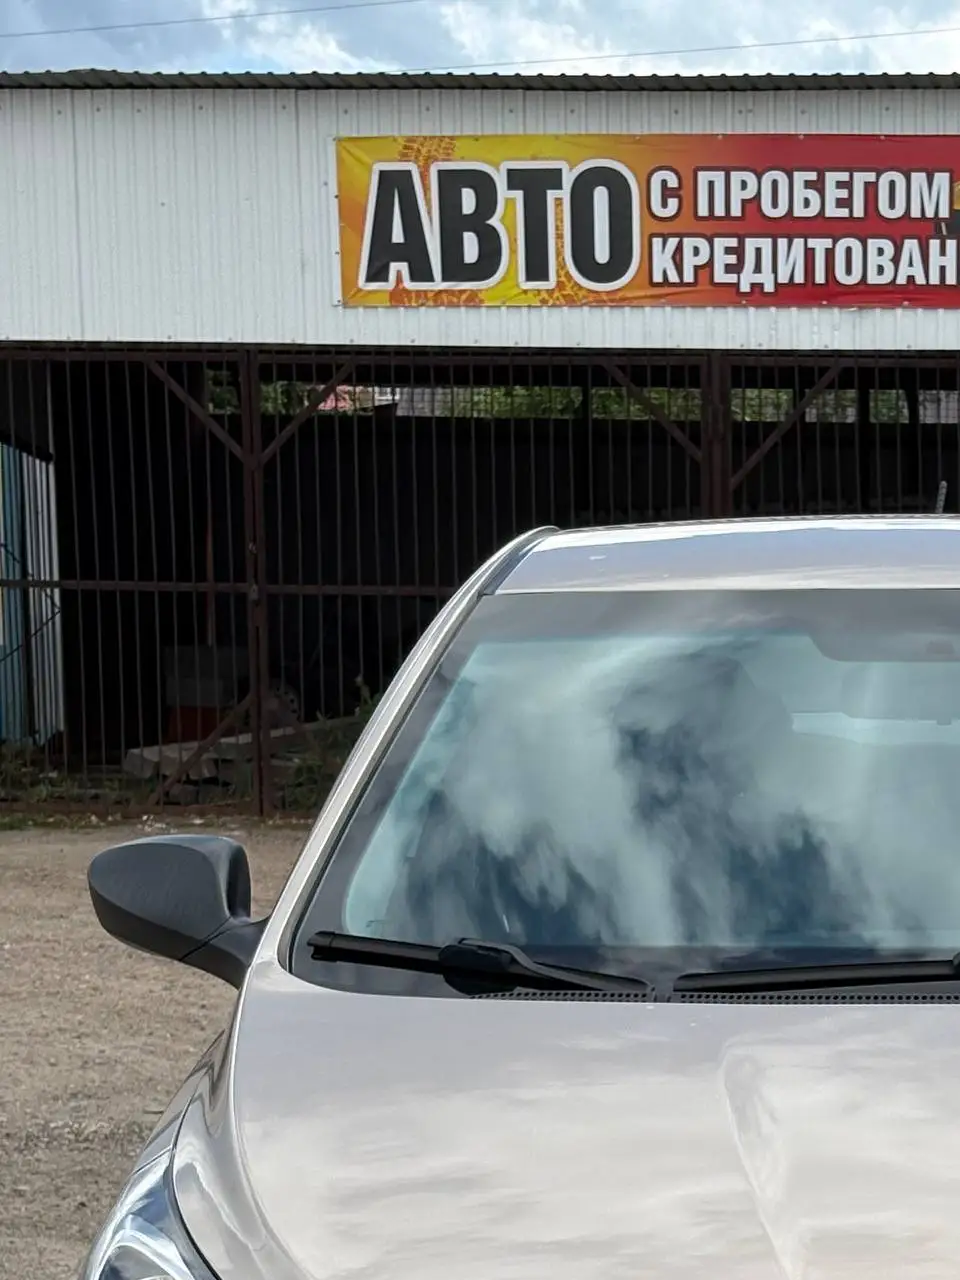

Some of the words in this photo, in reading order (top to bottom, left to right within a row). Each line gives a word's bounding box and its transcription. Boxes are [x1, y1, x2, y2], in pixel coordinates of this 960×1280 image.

[361, 162, 638, 288] АВТО
[650, 169, 680, 219] С
[696, 169, 951, 220] ПРОБЕГОМ
